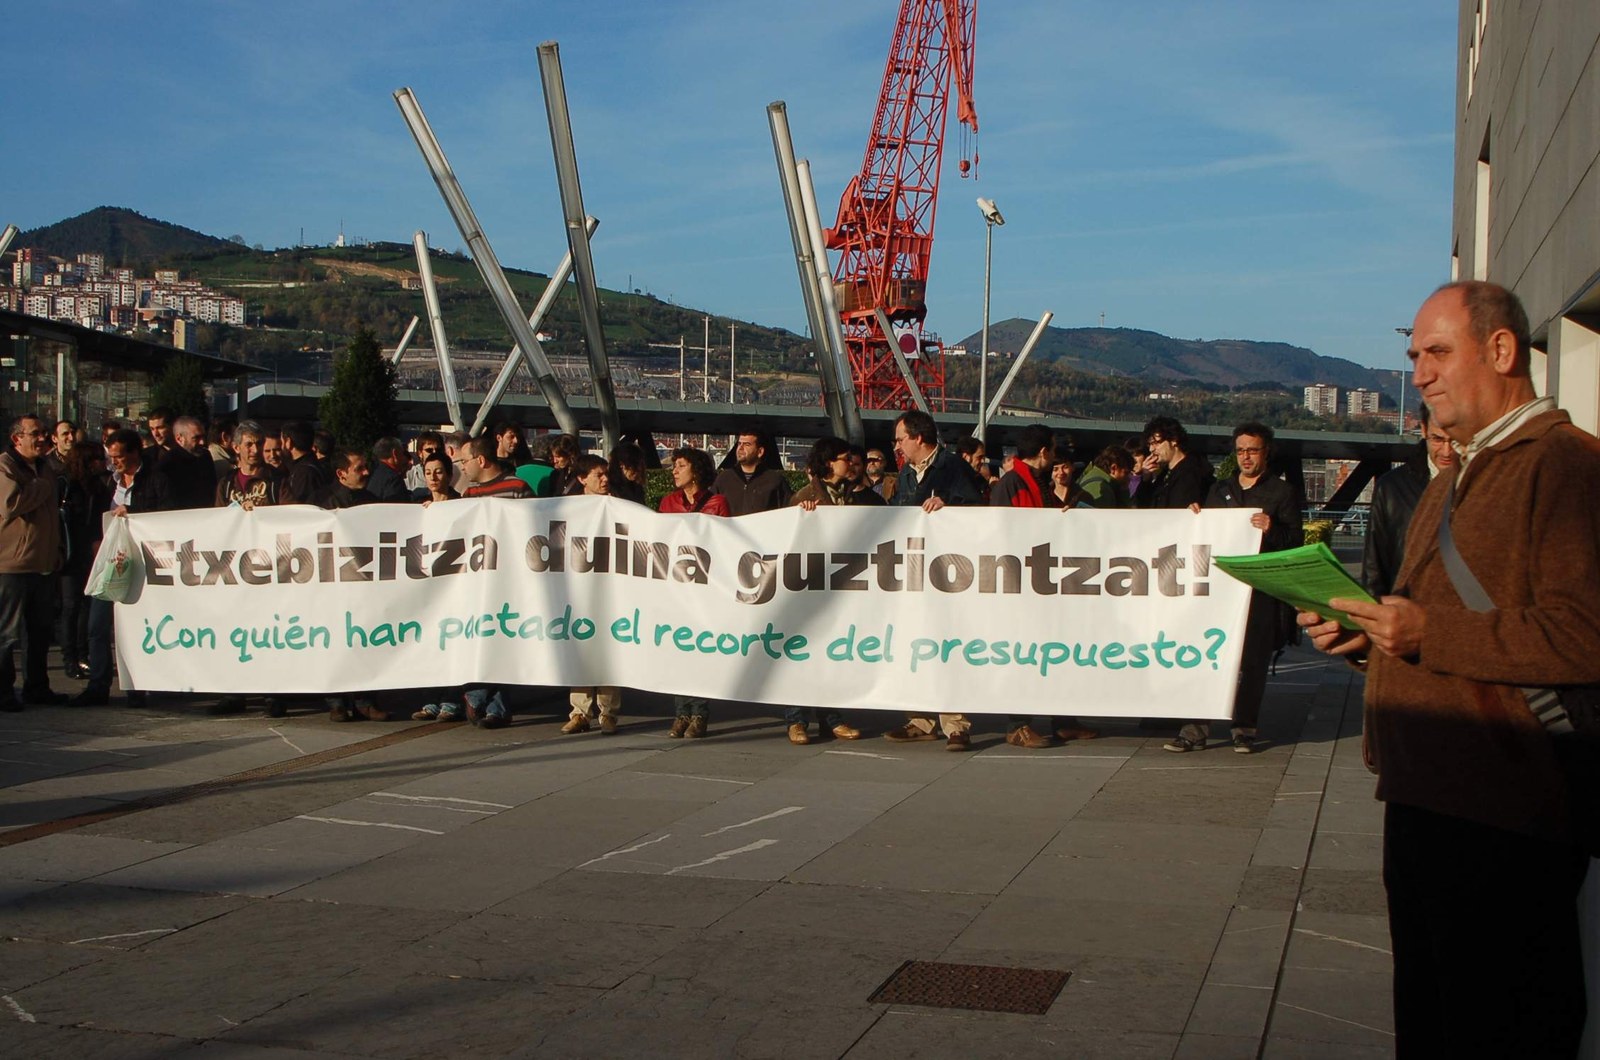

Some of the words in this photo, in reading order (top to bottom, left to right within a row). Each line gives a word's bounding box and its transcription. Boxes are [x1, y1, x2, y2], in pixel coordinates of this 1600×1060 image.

[141, 530, 498, 587] Etxebizitza
[525, 520, 711, 586] duina
[735, 537, 1213, 606] guztiontzat!
[142, 613, 216, 655] ¿Con
[229, 613, 330, 663] quién
[346, 612, 421, 649] han
[439, 603, 596, 650] pactado
[611, 608, 640, 645] el
[654, 623, 810, 662] recorte
[826, 624, 893, 664] del
[910, 628, 1227, 675] presupuesto?
